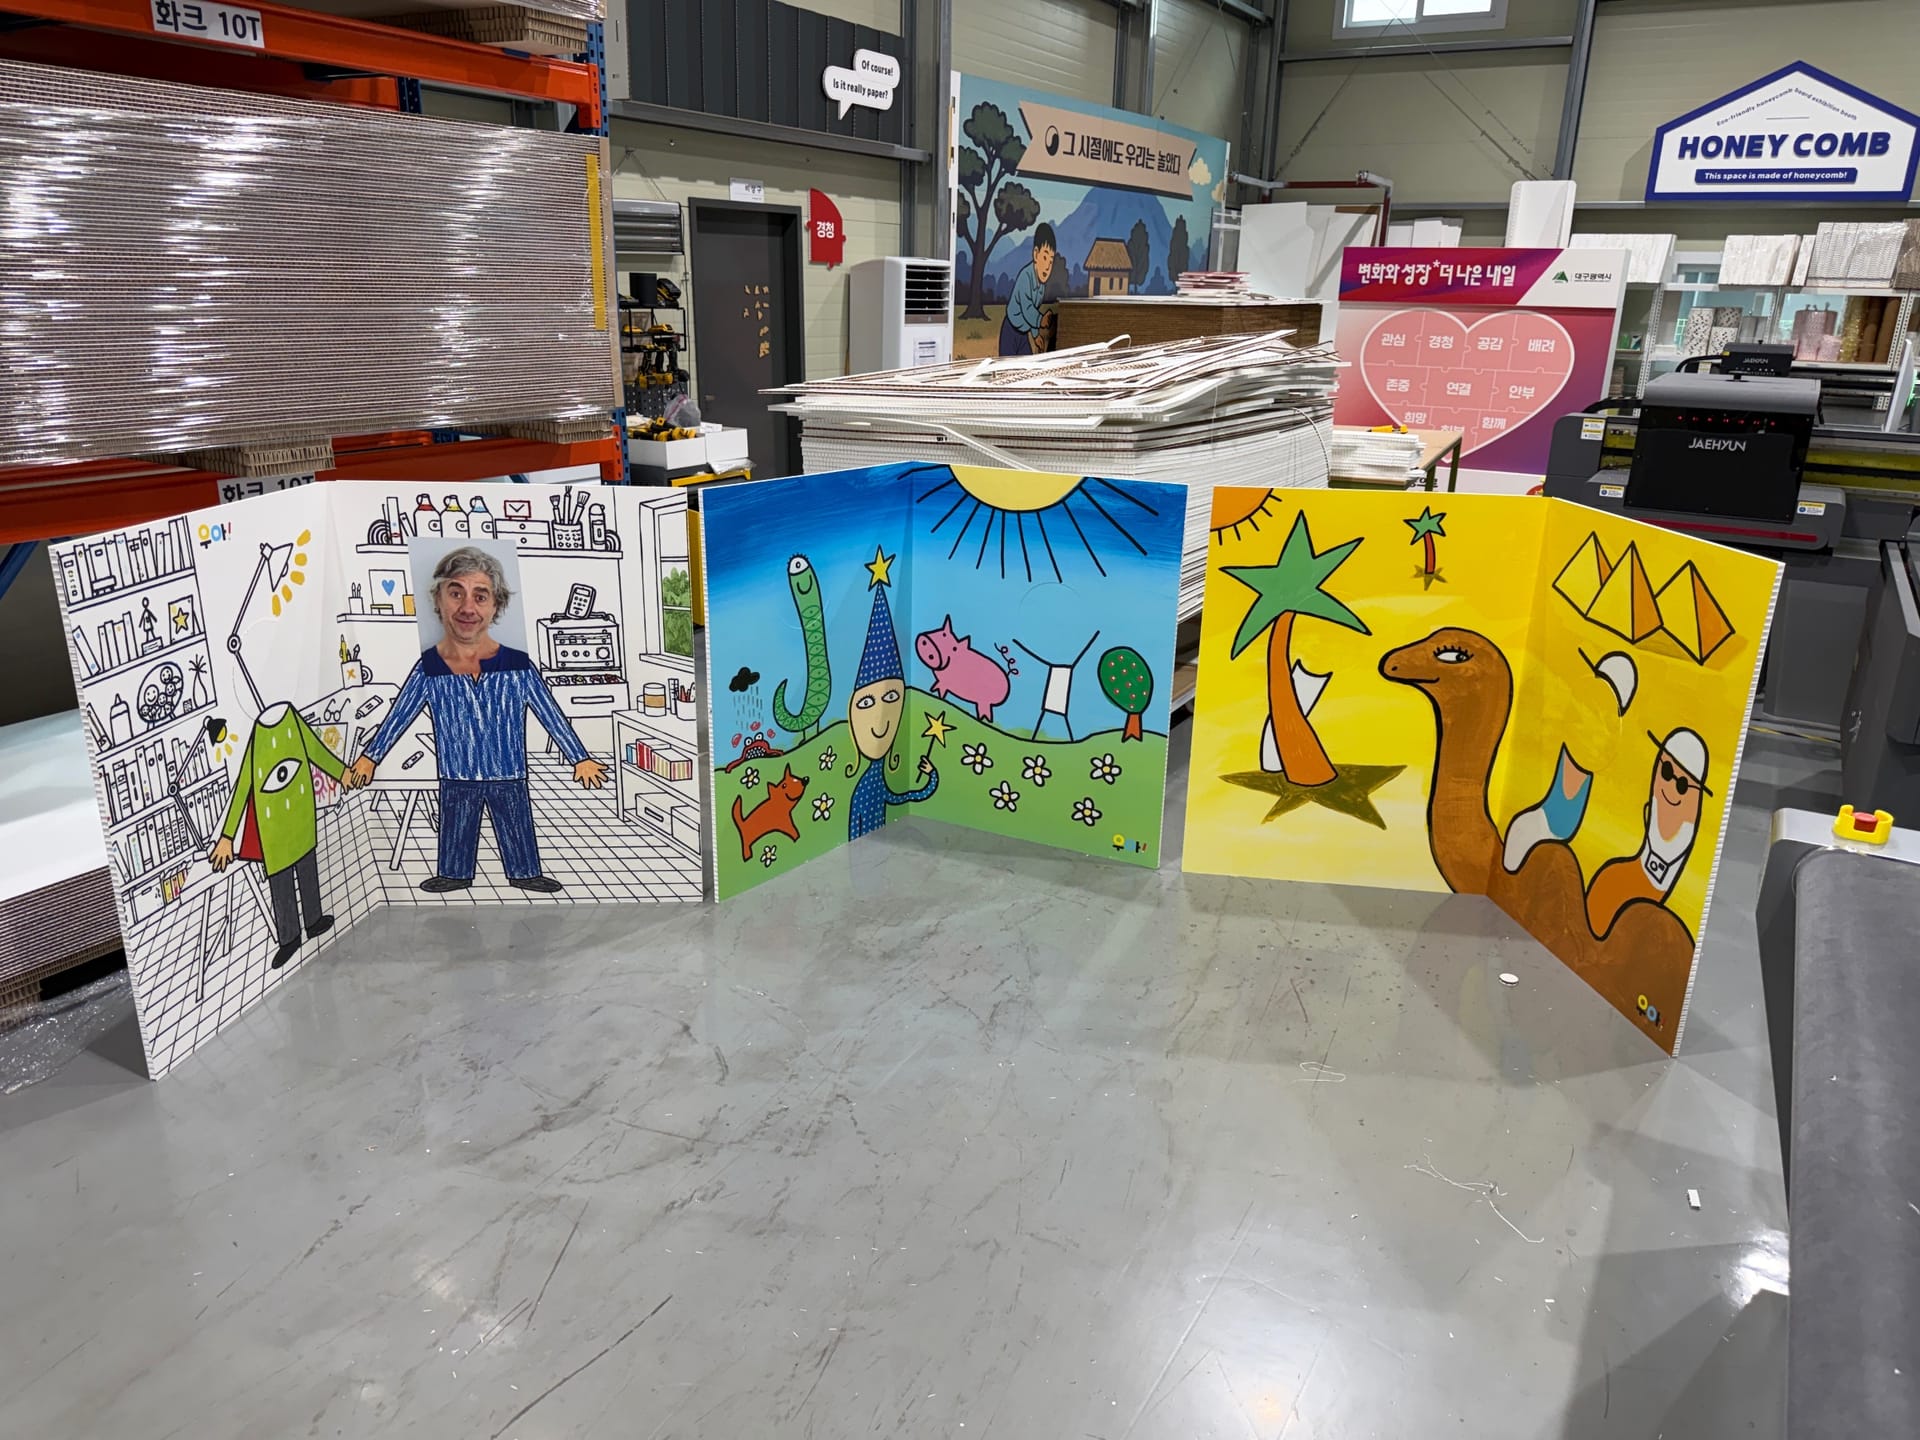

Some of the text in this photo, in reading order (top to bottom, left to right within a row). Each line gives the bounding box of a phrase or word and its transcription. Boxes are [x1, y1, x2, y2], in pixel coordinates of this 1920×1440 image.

[155, 0, 260, 41] 화크 10T
[861, 60, 894, 77] Of course!
[832, 78, 889, 99] Is it really paper?
[1716, 106, 1755, 126] Eco-friendly
[1678, 131, 1891, 159] HONEY COMB
[1062, 131, 1182, 175] 그 시절에도 우리는 놀았다
[1704, 171, 1848, 181] This space is made of honeycomb!
[816, 221, 835, 239] 경청
[1358, 263, 1400, 285] 변화와
[1401, 264, 1432, 286] 성장
[1456, 264, 1483, 286] 나은
[1486, 264, 1516, 287] 내일
[1381, 333, 1406, 347] 관심
[1428, 335, 1454, 349] 경청
[1477, 336, 1503, 351] 공감
[1527, 338, 1556, 353] 배려
[1386, 378, 1411, 392] 존중
[1446, 382, 1472, 397] 연결
[1509, 385, 1536, 400] 안부
[1404, 412, 1427, 425] 희망
[1481, 416, 1507, 430] 함께
[1688, 438, 1747, 452] JAEHYUN
